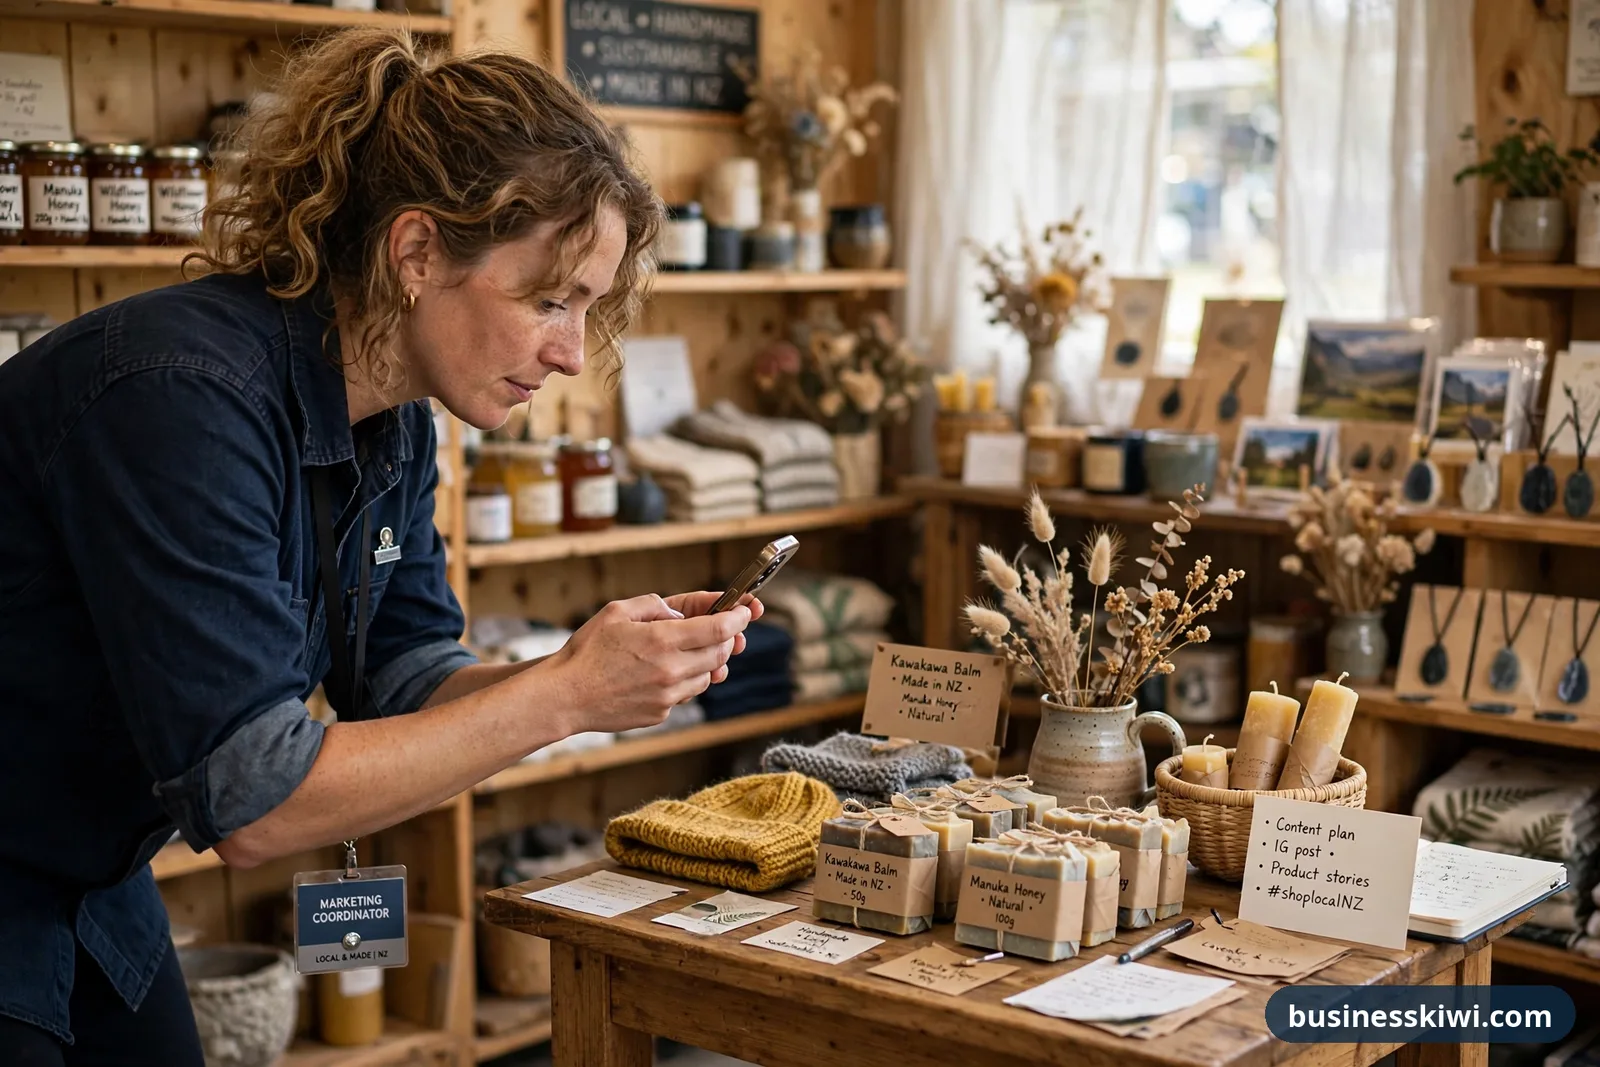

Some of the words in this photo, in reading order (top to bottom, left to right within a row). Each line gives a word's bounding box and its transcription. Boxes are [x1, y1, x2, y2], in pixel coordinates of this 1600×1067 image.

[569, 1, 633, 34] LOCAL
[890, 654, 948, 674] Kawakawa
[953, 661, 982, 678] Balm
[901, 674, 929, 689] Made
[932, 678, 942, 690] in
[945, 680, 963, 693] NZ
[901, 693, 932, 705] Manuka
[936, 697, 960, 713] Honey
[907, 706, 945, 723] Natural
[1276, 817, 1323, 836] Content
[1328, 824, 1356, 842] plan
[1274, 839, 1289, 854] IG
[1294, 844, 1322, 860] post
[824, 852, 870, 872] Kawakawa
[874, 861, 898, 878] Balm
[1271, 860, 1320, 880] Product
[1326, 869, 1371, 888] stories
[835, 871, 857, 885] Made
[860, 876, 868, 887] in
[870, 878, 884, 891] NZ
[970, 874, 1009, 894] Manuka
[1014, 882, 1046, 904] Honey
[320, 894, 383, 910] MARKETING
[850, 889, 866, 906] 50g
[988, 894, 1025, 913] Natural
[1267, 884, 1365, 912] #shoplocalNZ
[312, 907, 390, 924] COORDINATOR
[995, 912, 1015, 930] 100g
[798, 926, 849, 943] Handmade
[315, 954, 340, 964] LOCAL
[341, 953, 348, 961] &
[349, 951, 372, 961] MADE
[377, 950, 389, 959] NZ
